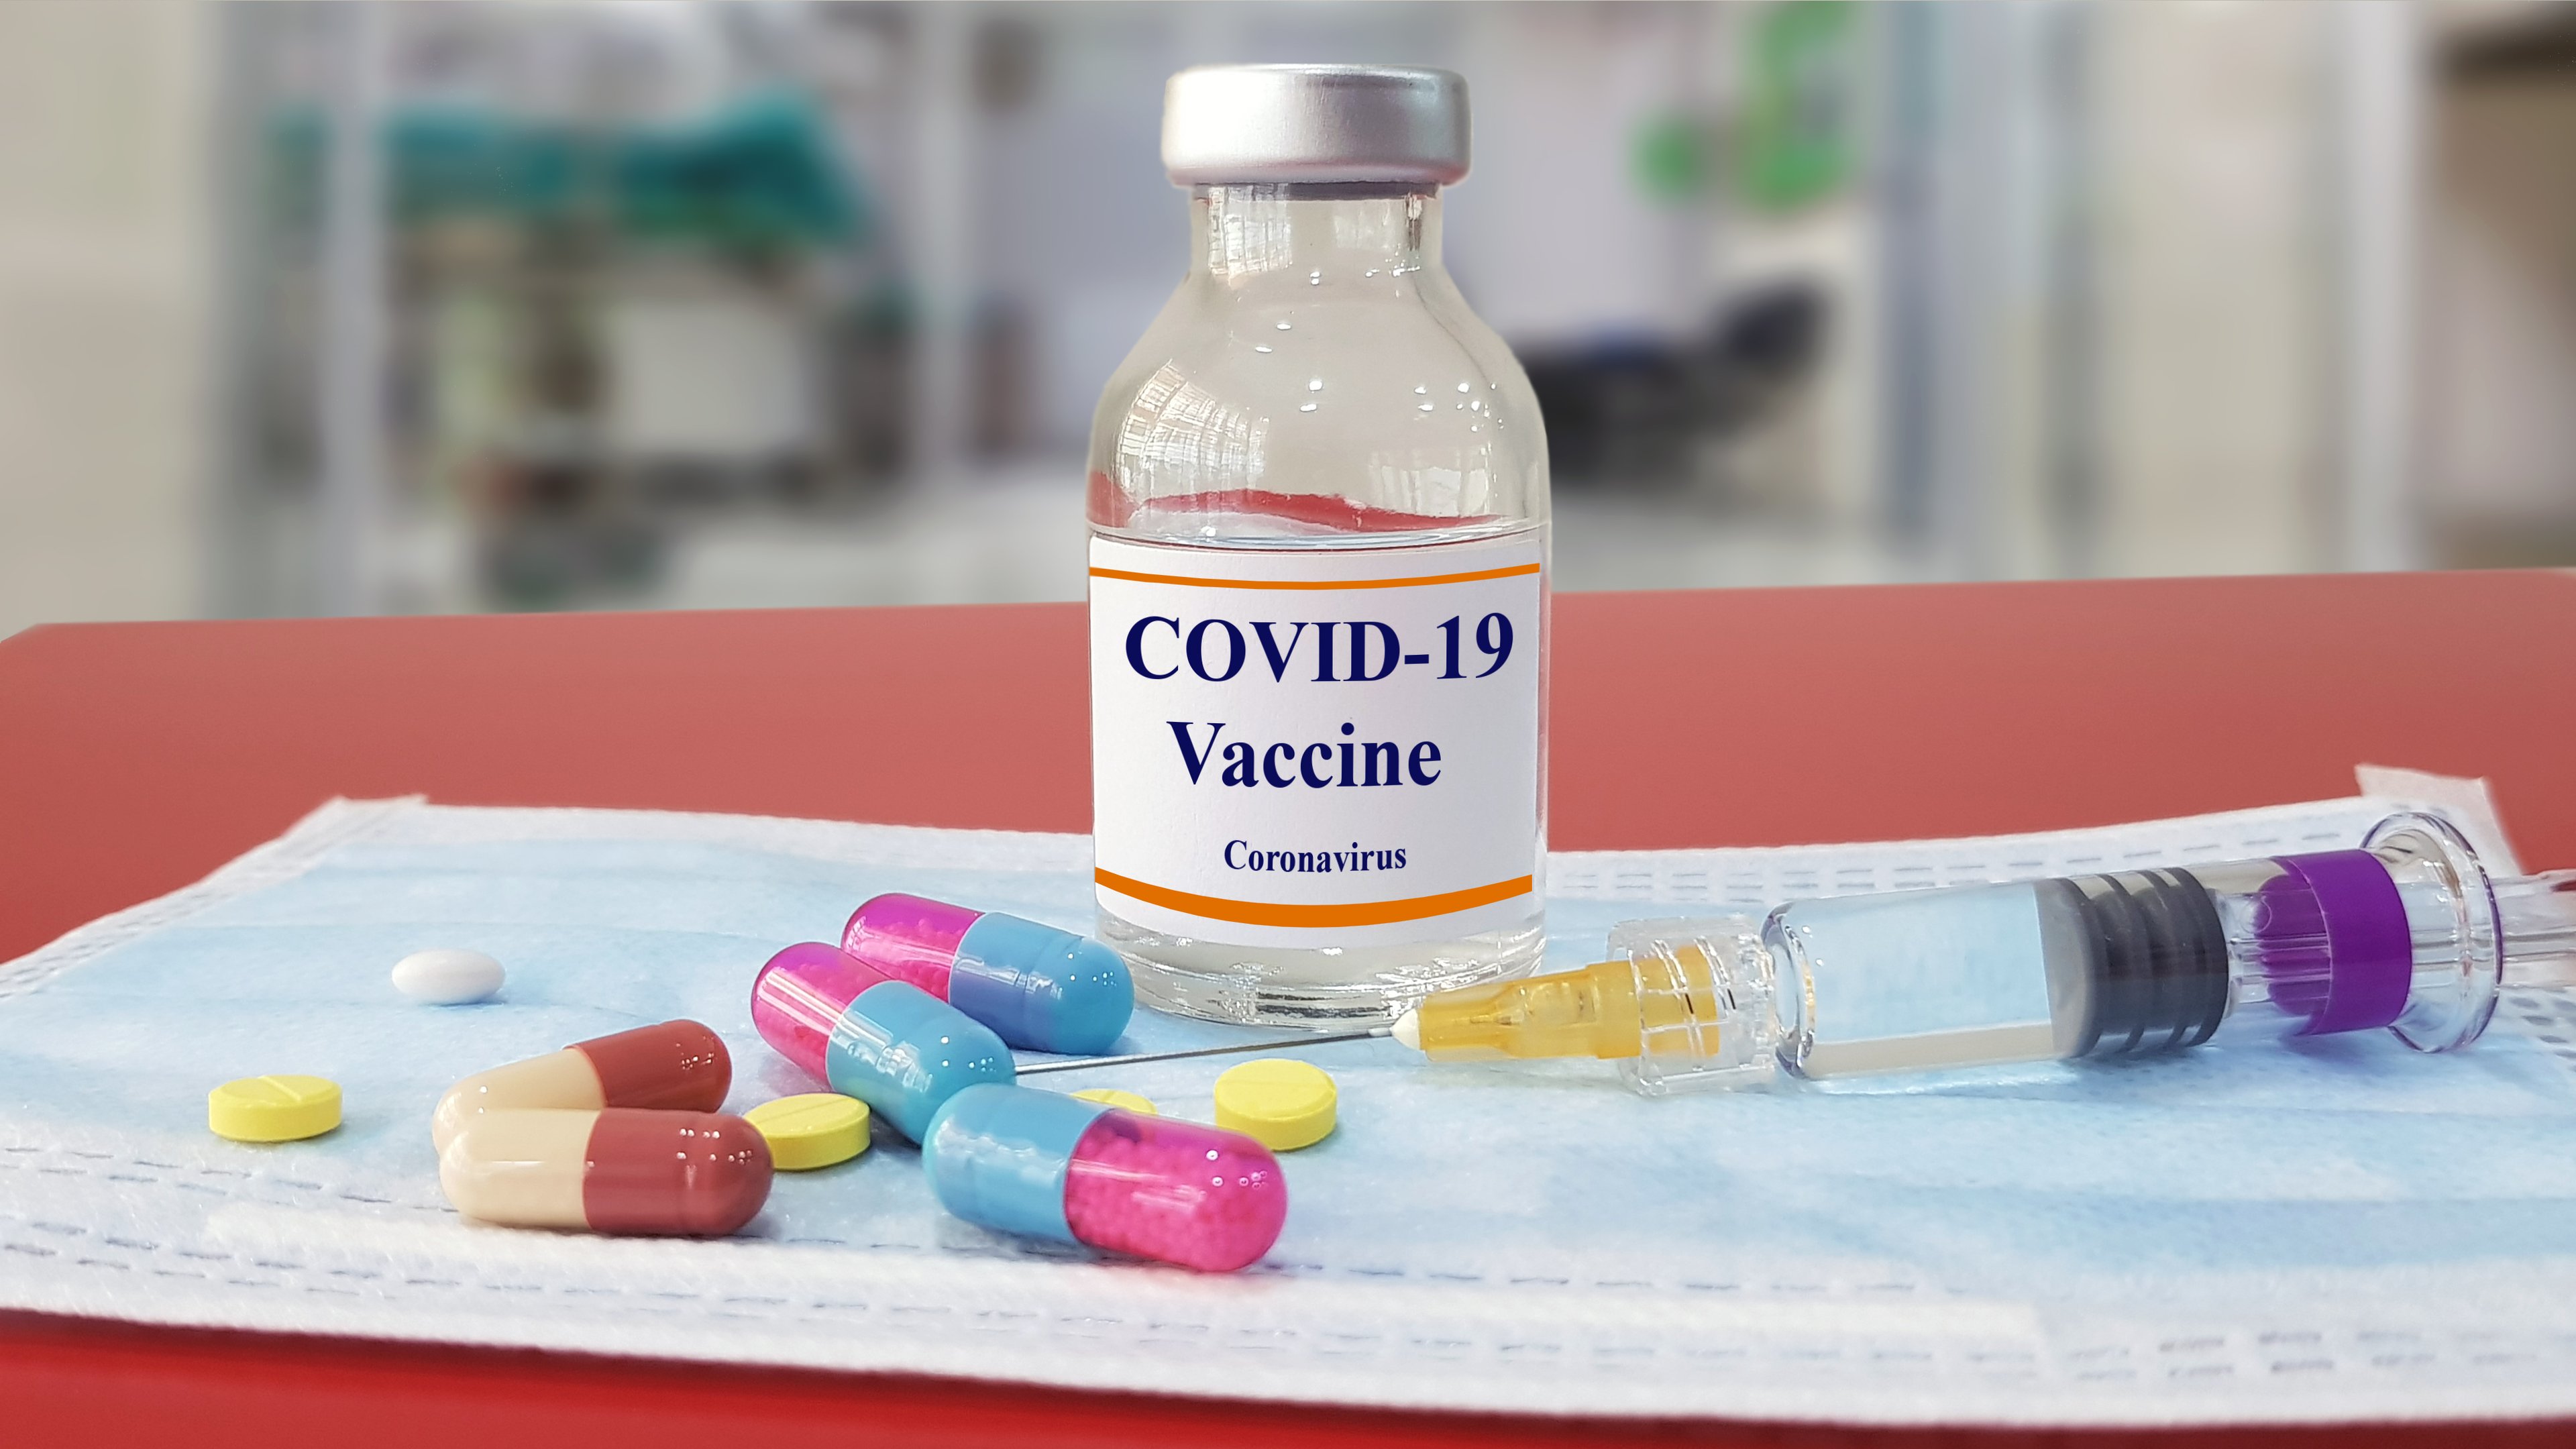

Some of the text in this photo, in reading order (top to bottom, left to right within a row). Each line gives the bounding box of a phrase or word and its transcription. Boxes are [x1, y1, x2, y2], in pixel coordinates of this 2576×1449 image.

[1126, 612, 1513, 683] COVID-19
[1166, 721, 1442, 788] Vaccine
[1224, 840, 1407, 873] Coronavirus
